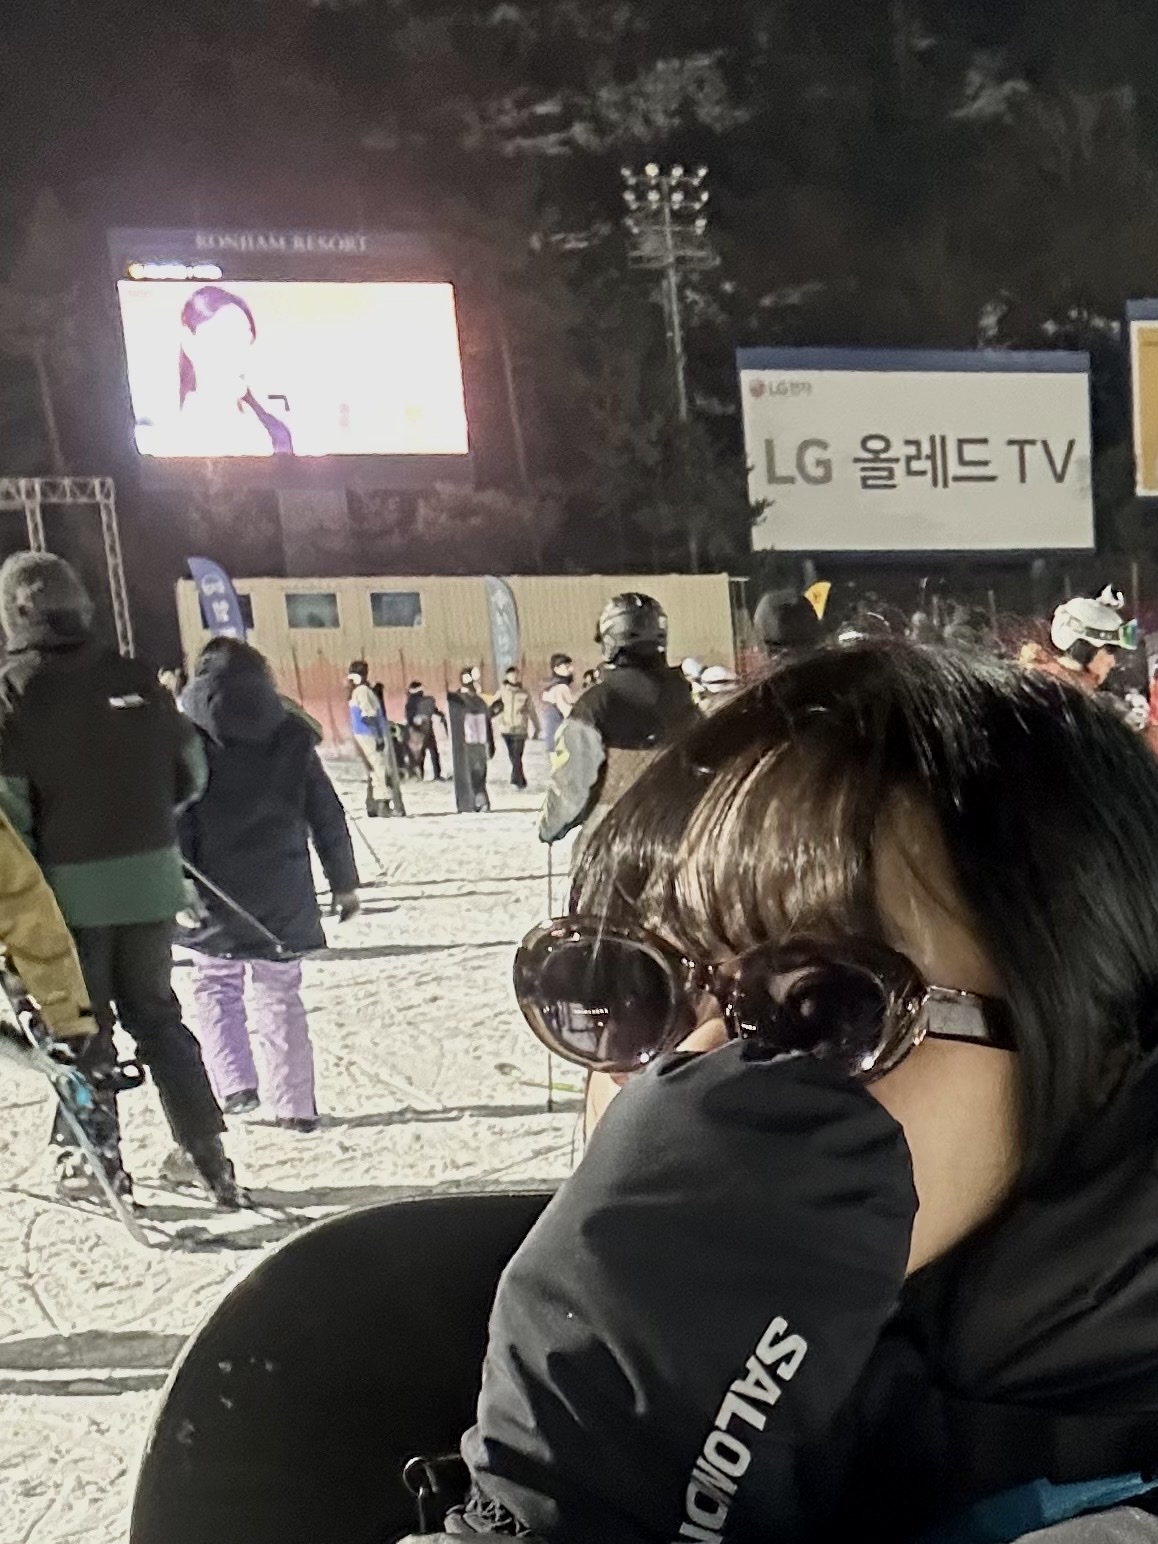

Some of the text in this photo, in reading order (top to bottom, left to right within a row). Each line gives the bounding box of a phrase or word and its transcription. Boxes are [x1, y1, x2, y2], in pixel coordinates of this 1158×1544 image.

[764, 434, 1076, 489] LG 올레드 TV
